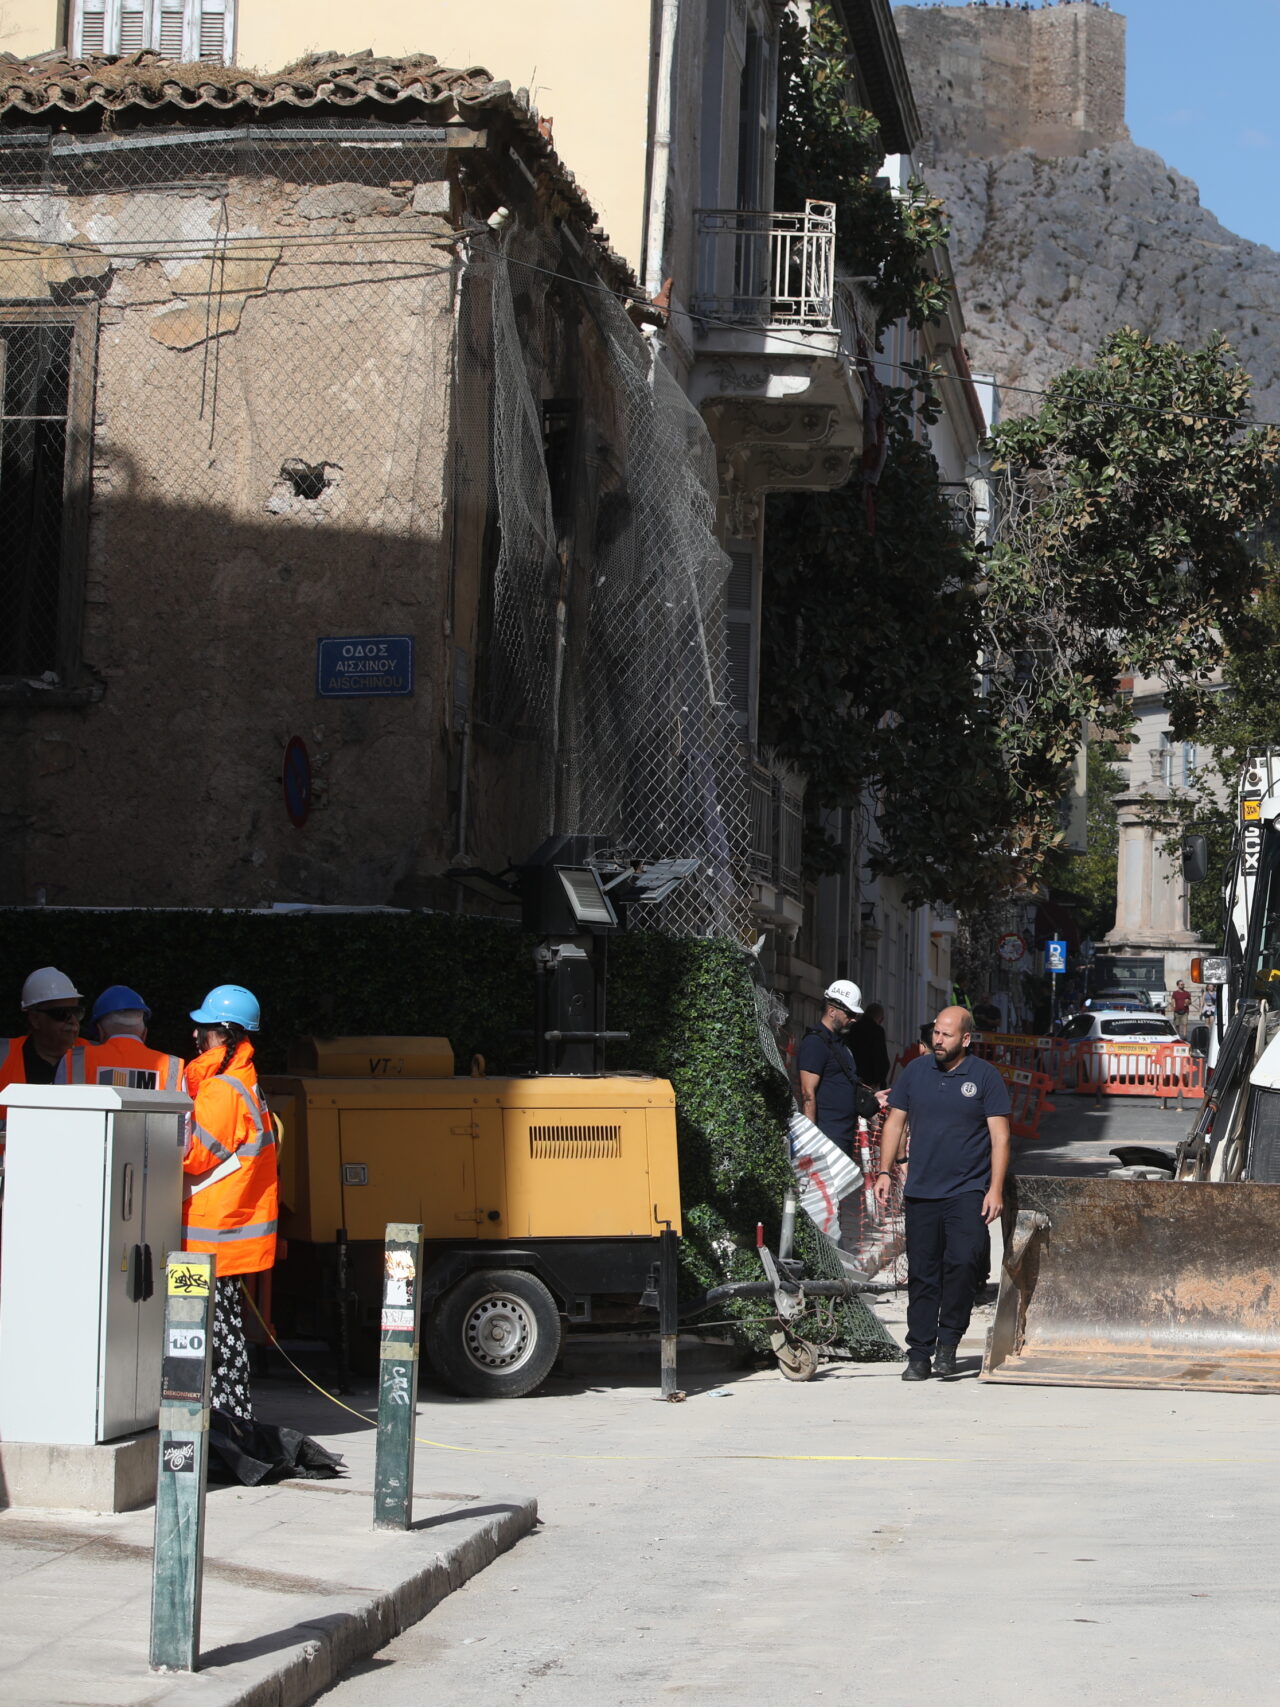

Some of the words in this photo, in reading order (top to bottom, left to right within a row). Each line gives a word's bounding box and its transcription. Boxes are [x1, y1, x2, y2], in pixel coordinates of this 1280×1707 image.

[342, 644, 388, 657] ΟΔΟΣ
[336, 659, 397, 672] ΑΙΣΧΙΝΟΥ
[328, 675, 403, 689] AISCHINOU
